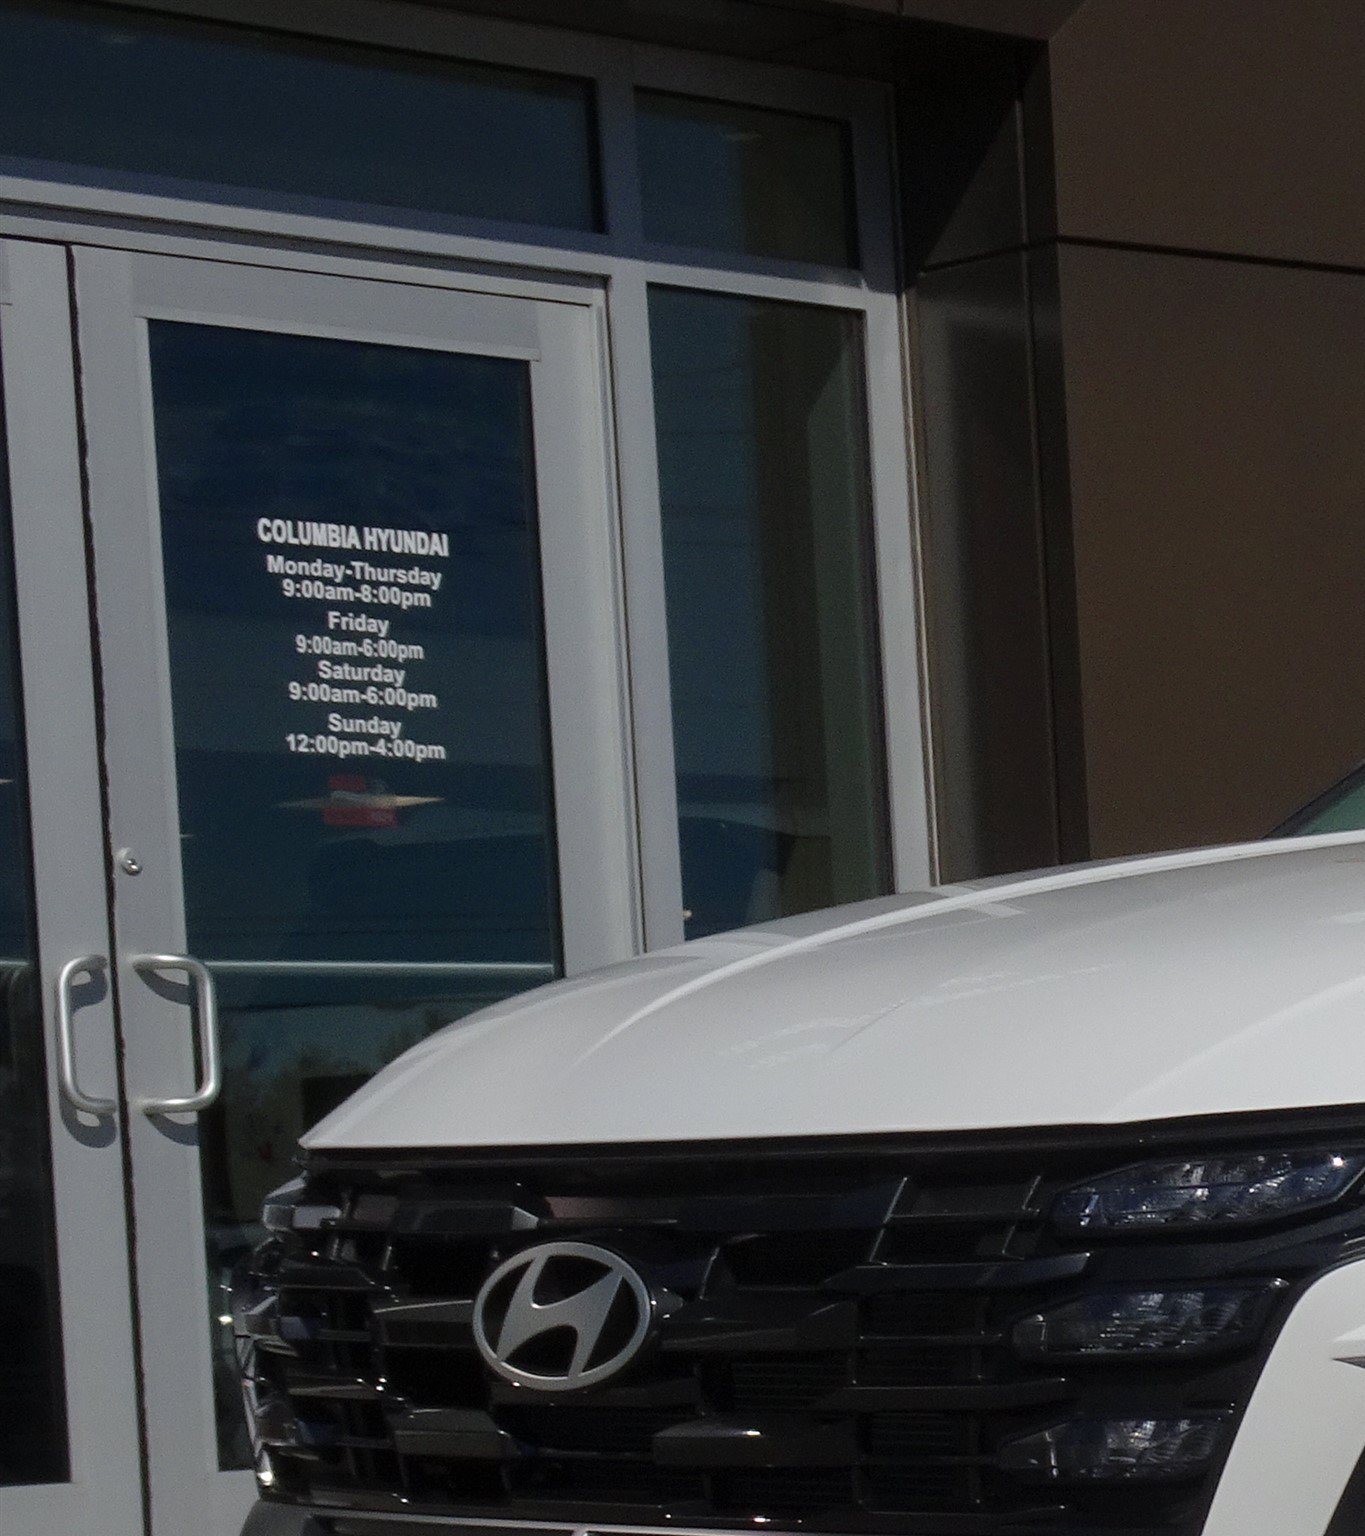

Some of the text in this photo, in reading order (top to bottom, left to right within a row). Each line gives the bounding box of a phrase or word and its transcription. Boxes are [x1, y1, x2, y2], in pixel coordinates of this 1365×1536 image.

[257, 517, 450, 557] COLUMBIA HYUNDAI
[266, 554, 442, 590] Monday-Thursday
[282, 578, 432, 609] 9:00am-8:00pm
[327, 611, 390, 637] Friday
[295, 634, 425, 662] 9:00am-6:00pm
[317, 660, 406, 687] Saturday
[288, 681, 438, 711] 9:00am-6:00pm
[327, 713, 402, 739] Sunday
[285, 733, 447, 763] 12:00pm-4:00pm
